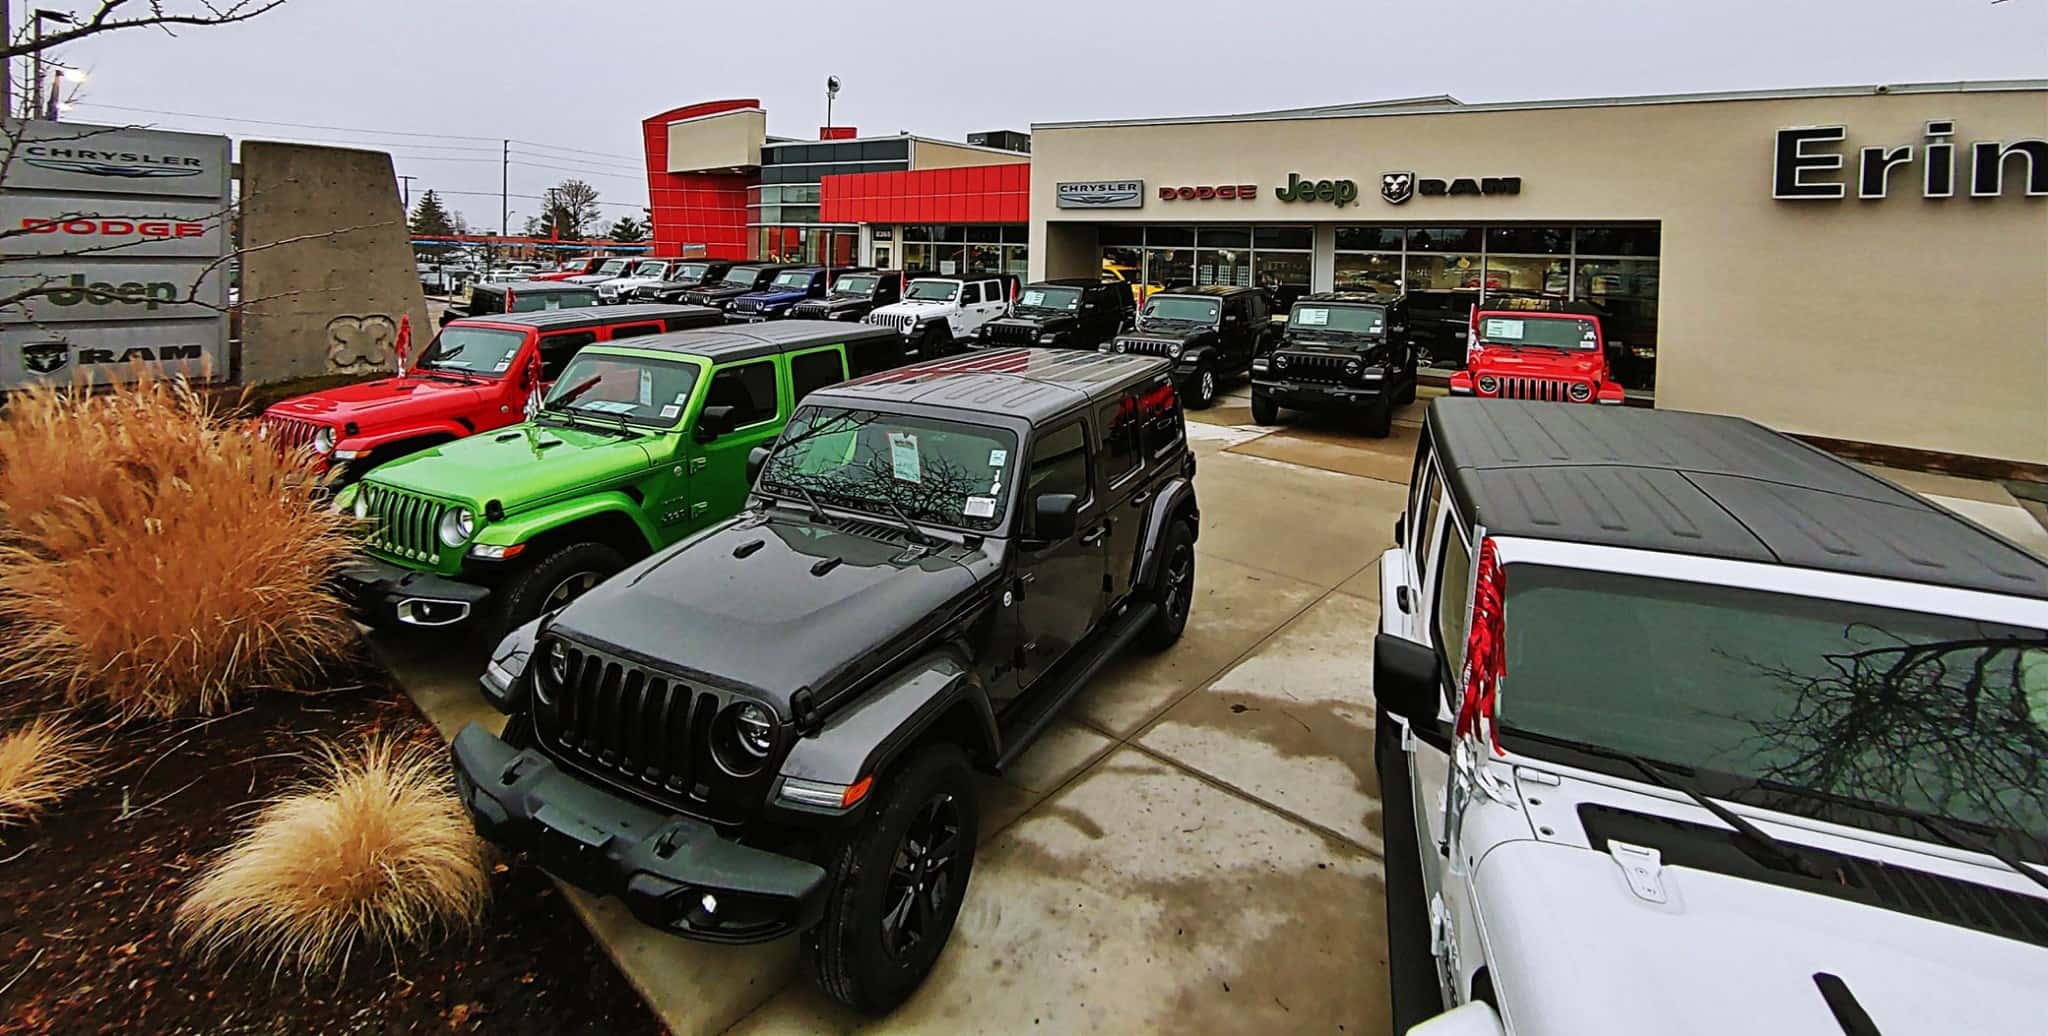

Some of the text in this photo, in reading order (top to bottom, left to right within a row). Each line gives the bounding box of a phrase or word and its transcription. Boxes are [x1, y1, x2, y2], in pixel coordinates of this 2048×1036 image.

[26, 147, 201, 166] CHRYSLER
[1772, 120, 2048, 199] Erin
[1059, 183, 1138, 192] CHRYSLER
[1158, 185, 1257, 200] DODGE
[1275, 173, 1358, 207] Jeep
[1418, 177, 1521, 195] RAM
[21, 218, 205, 237] DODGE
[47, 274, 177, 310] Jeep
[79, 345, 202, 364] RAM
